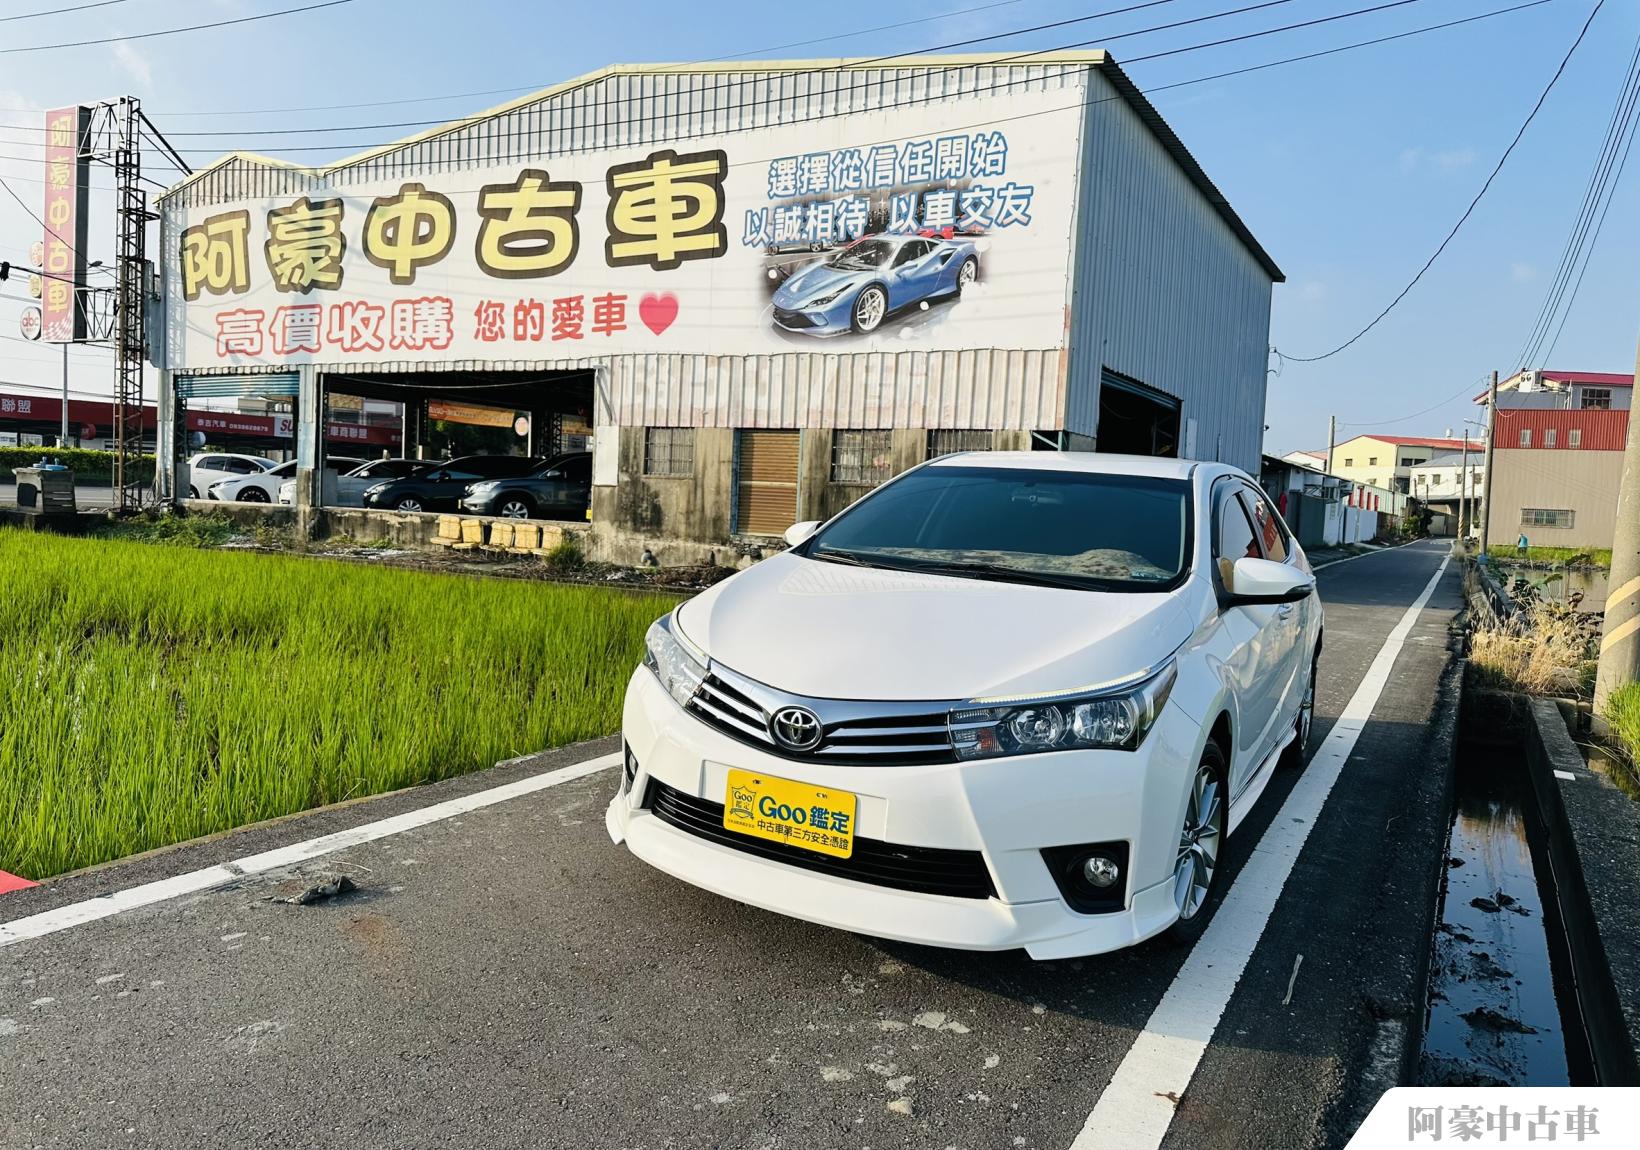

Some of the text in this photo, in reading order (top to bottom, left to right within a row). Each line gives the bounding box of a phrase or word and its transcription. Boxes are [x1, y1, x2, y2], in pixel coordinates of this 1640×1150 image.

[767, 131, 1008, 199] 選擇從信任開始
[47, 115, 72, 313] 阿豪中古車
[180, 149, 727, 300] 阿豪中古車
[742, 182, 1034, 247] 以誠相待 以車交友
[216, 293, 629, 357] 高價收購 您的愛車
[1, 398, 31, 413] 聯盟
[733, 790, 753, 803] Goo
[759, 796, 850, 835] Goo 鑑定
[757, 819, 849, 851] 中古車第三方安全憑證
